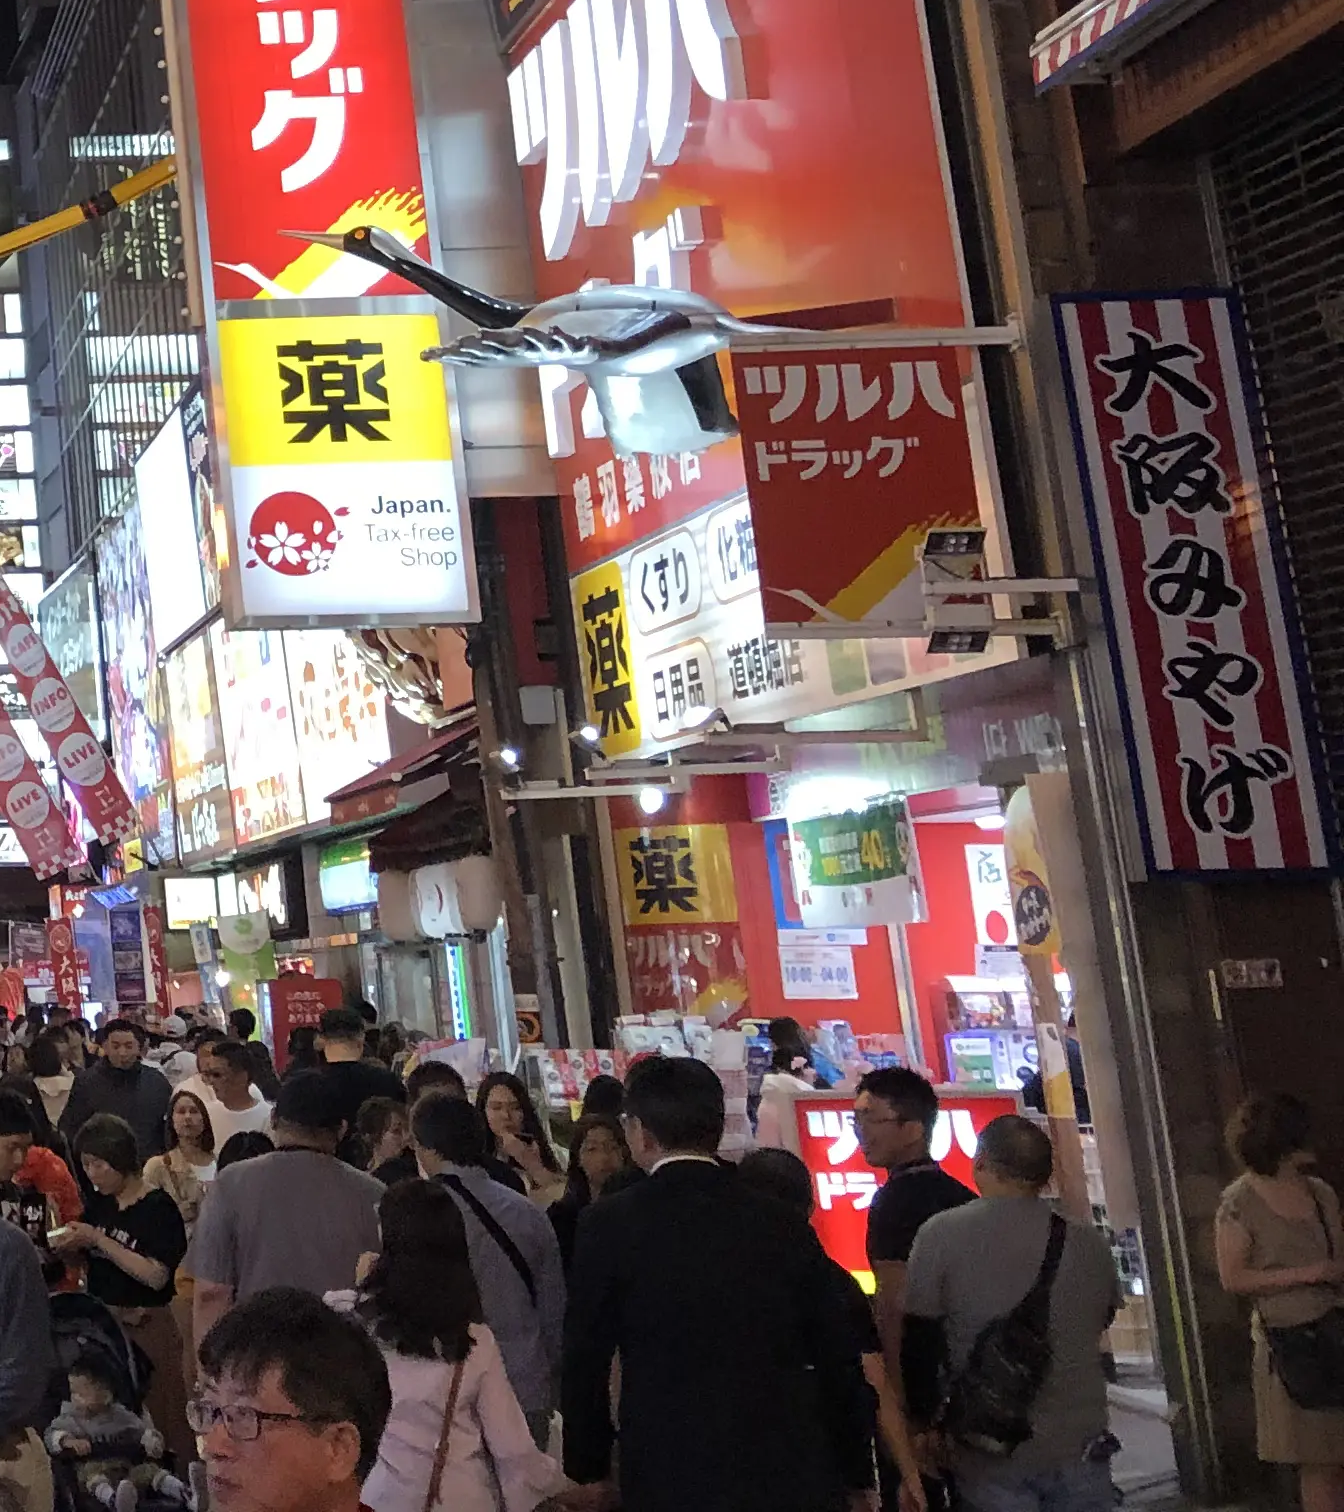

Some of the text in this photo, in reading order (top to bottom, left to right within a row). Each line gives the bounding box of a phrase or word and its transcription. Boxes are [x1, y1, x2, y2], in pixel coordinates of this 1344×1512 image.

[277, 340, 392, 444] 薬
[743, 361, 956, 425] ツルハ
[755, 435, 921, 483] ドラッグ
[371, 495, 451, 519] Japan.
[364, 523, 455, 543] Tax-free
[401, 547, 458, 571] Shop
[640, 548, 690, 615] くすり
[1097, 332, 1292, 837] 大阪みやげ
[582, 587, 636, 738] 薬
[33, 687, 68, 716] INFO
[63, 742, 97, 769] LIVE
[10, 790, 41, 814] LIVE
[629, 835, 700, 914] 薬
